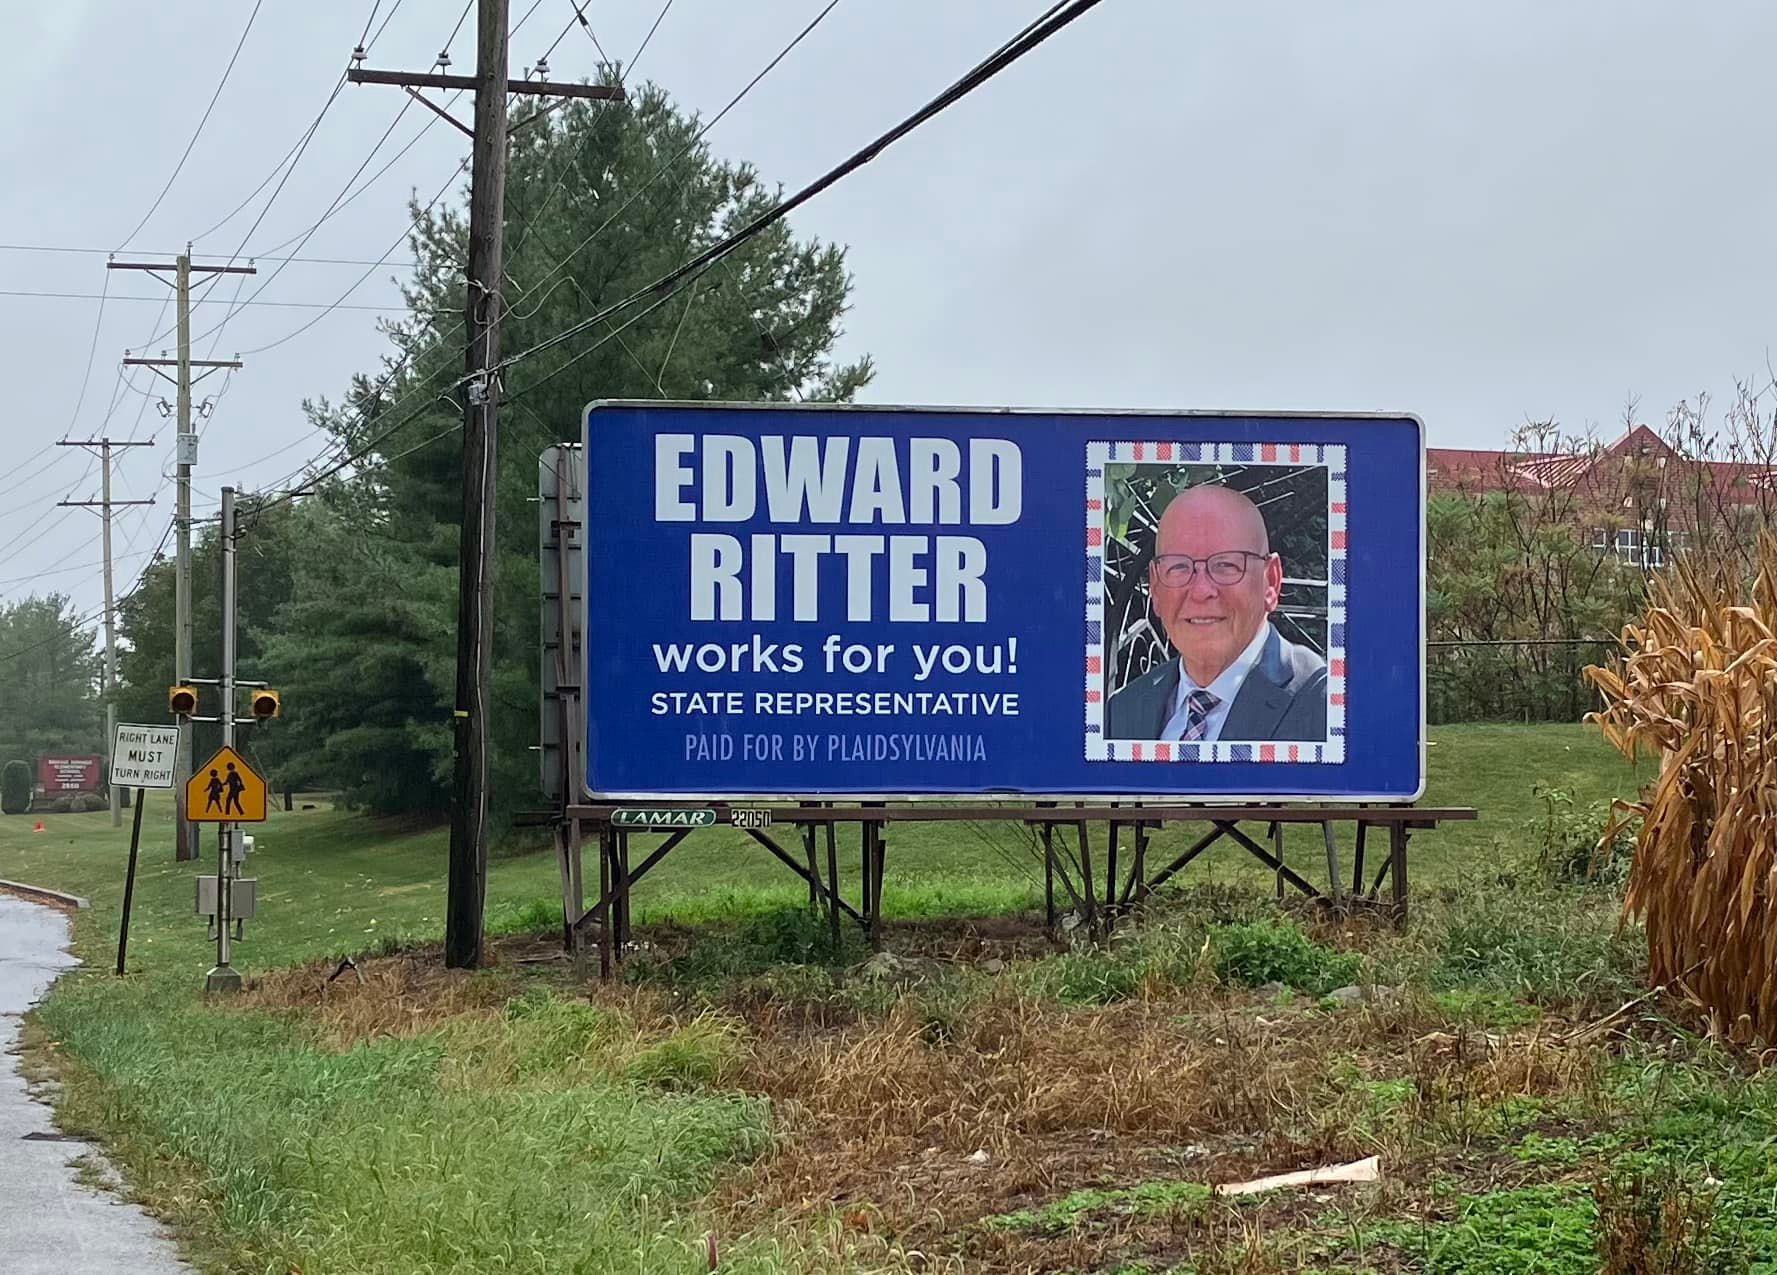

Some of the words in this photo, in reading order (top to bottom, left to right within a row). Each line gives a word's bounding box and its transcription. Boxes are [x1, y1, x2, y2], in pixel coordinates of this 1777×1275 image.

[655, 433, 1023, 525] EDWARD
[690, 533, 988, 623] RITTER
[652, 634, 803, 674] works
[823, 634, 895, 674] for
[912, 636, 1019, 682] you!
[650, 692, 744, 716] STATE
[755, 692, 1020, 716] REPRESENTATIVE
[119, 732, 147, 744] RIGHT
[150, 734, 175, 745] LANE
[684, 733, 734, 762] PAID
[743, 733, 784, 761] FOR
[792, 733, 819, 761] BY
[827, 733, 988, 762] PLAIDSYLVANIA
[127, 749, 163, 763] MUST
[114, 767, 140, 779] TURN
[143, 769, 171, 780] RIGHT
[619, 811, 707, 825] LAMAR
[731, 810, 771, 828] 22050
